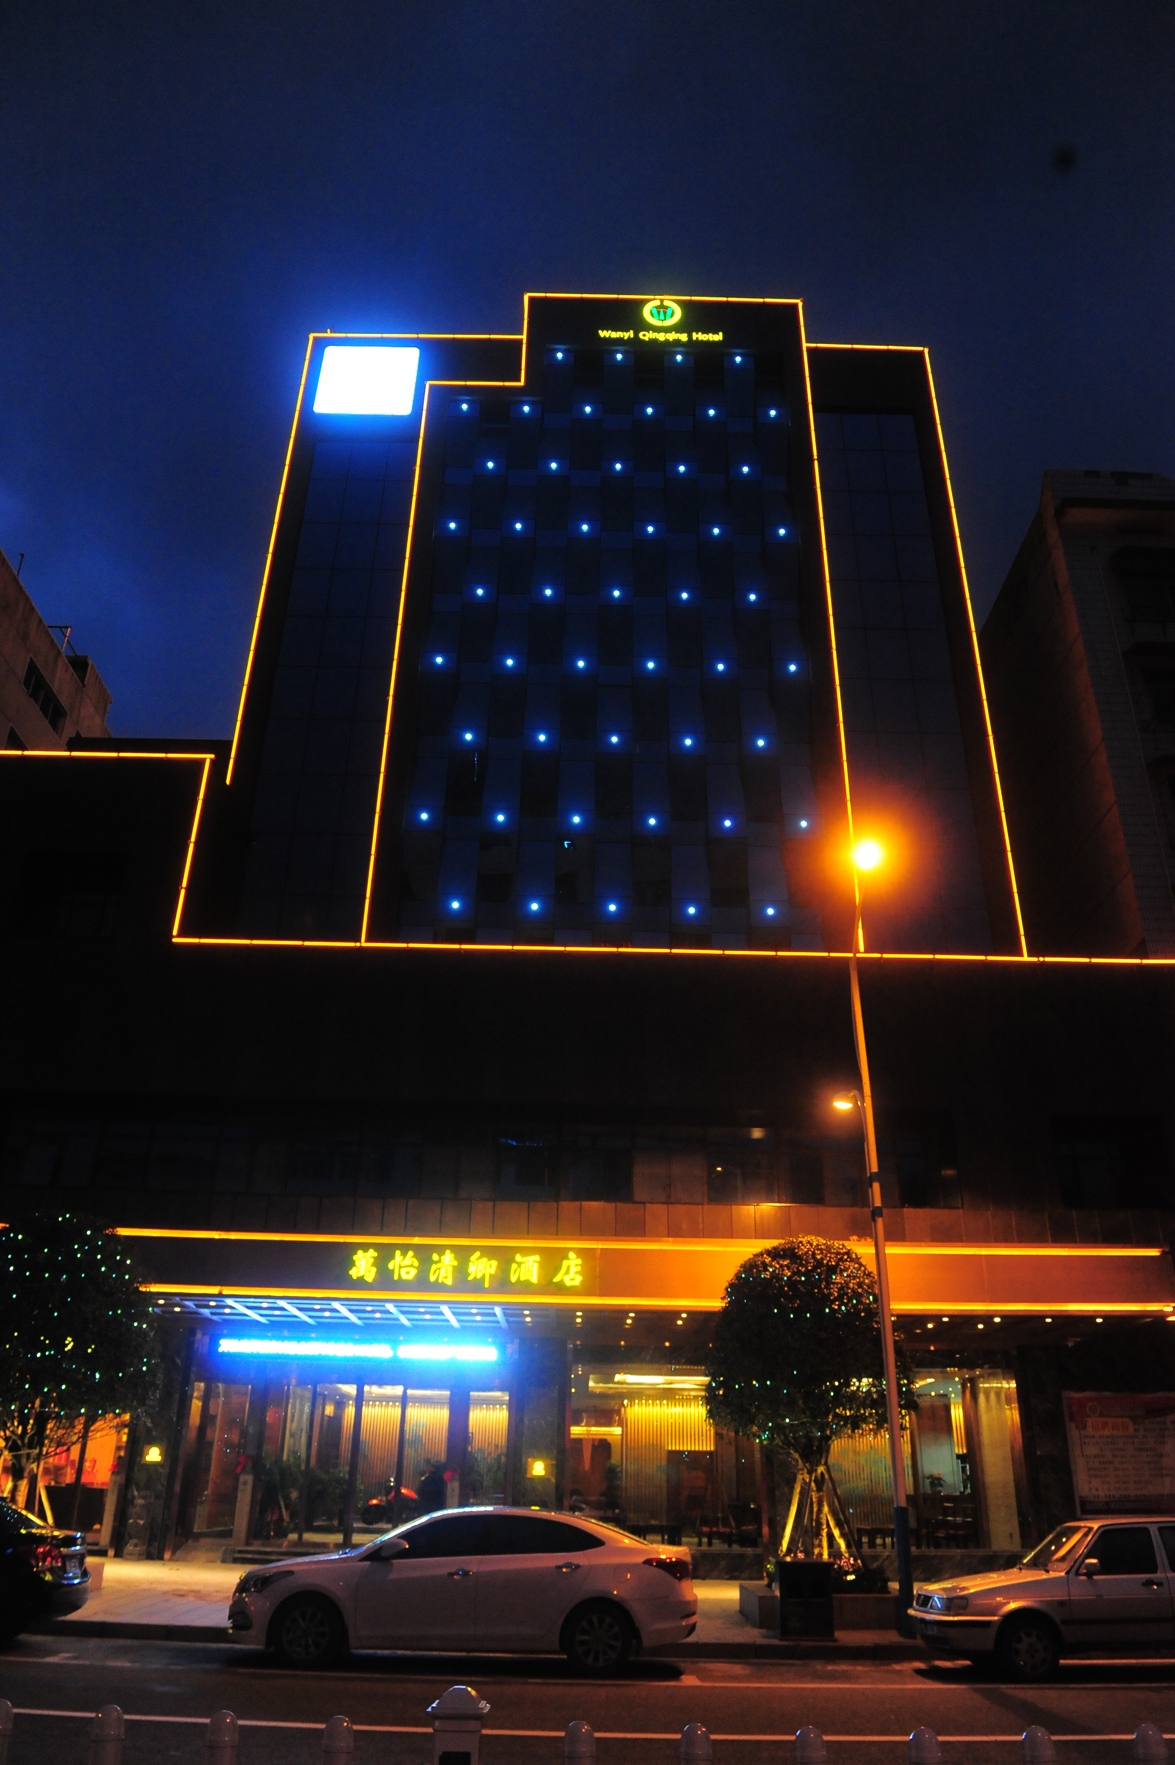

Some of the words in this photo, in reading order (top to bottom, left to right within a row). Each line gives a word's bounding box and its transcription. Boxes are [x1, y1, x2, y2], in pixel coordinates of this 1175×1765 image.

[598, 329, 634, 340] Wanyi
[638, 330, 688, 342] Qingqing
[692, 331, 723, 341] Hotel
